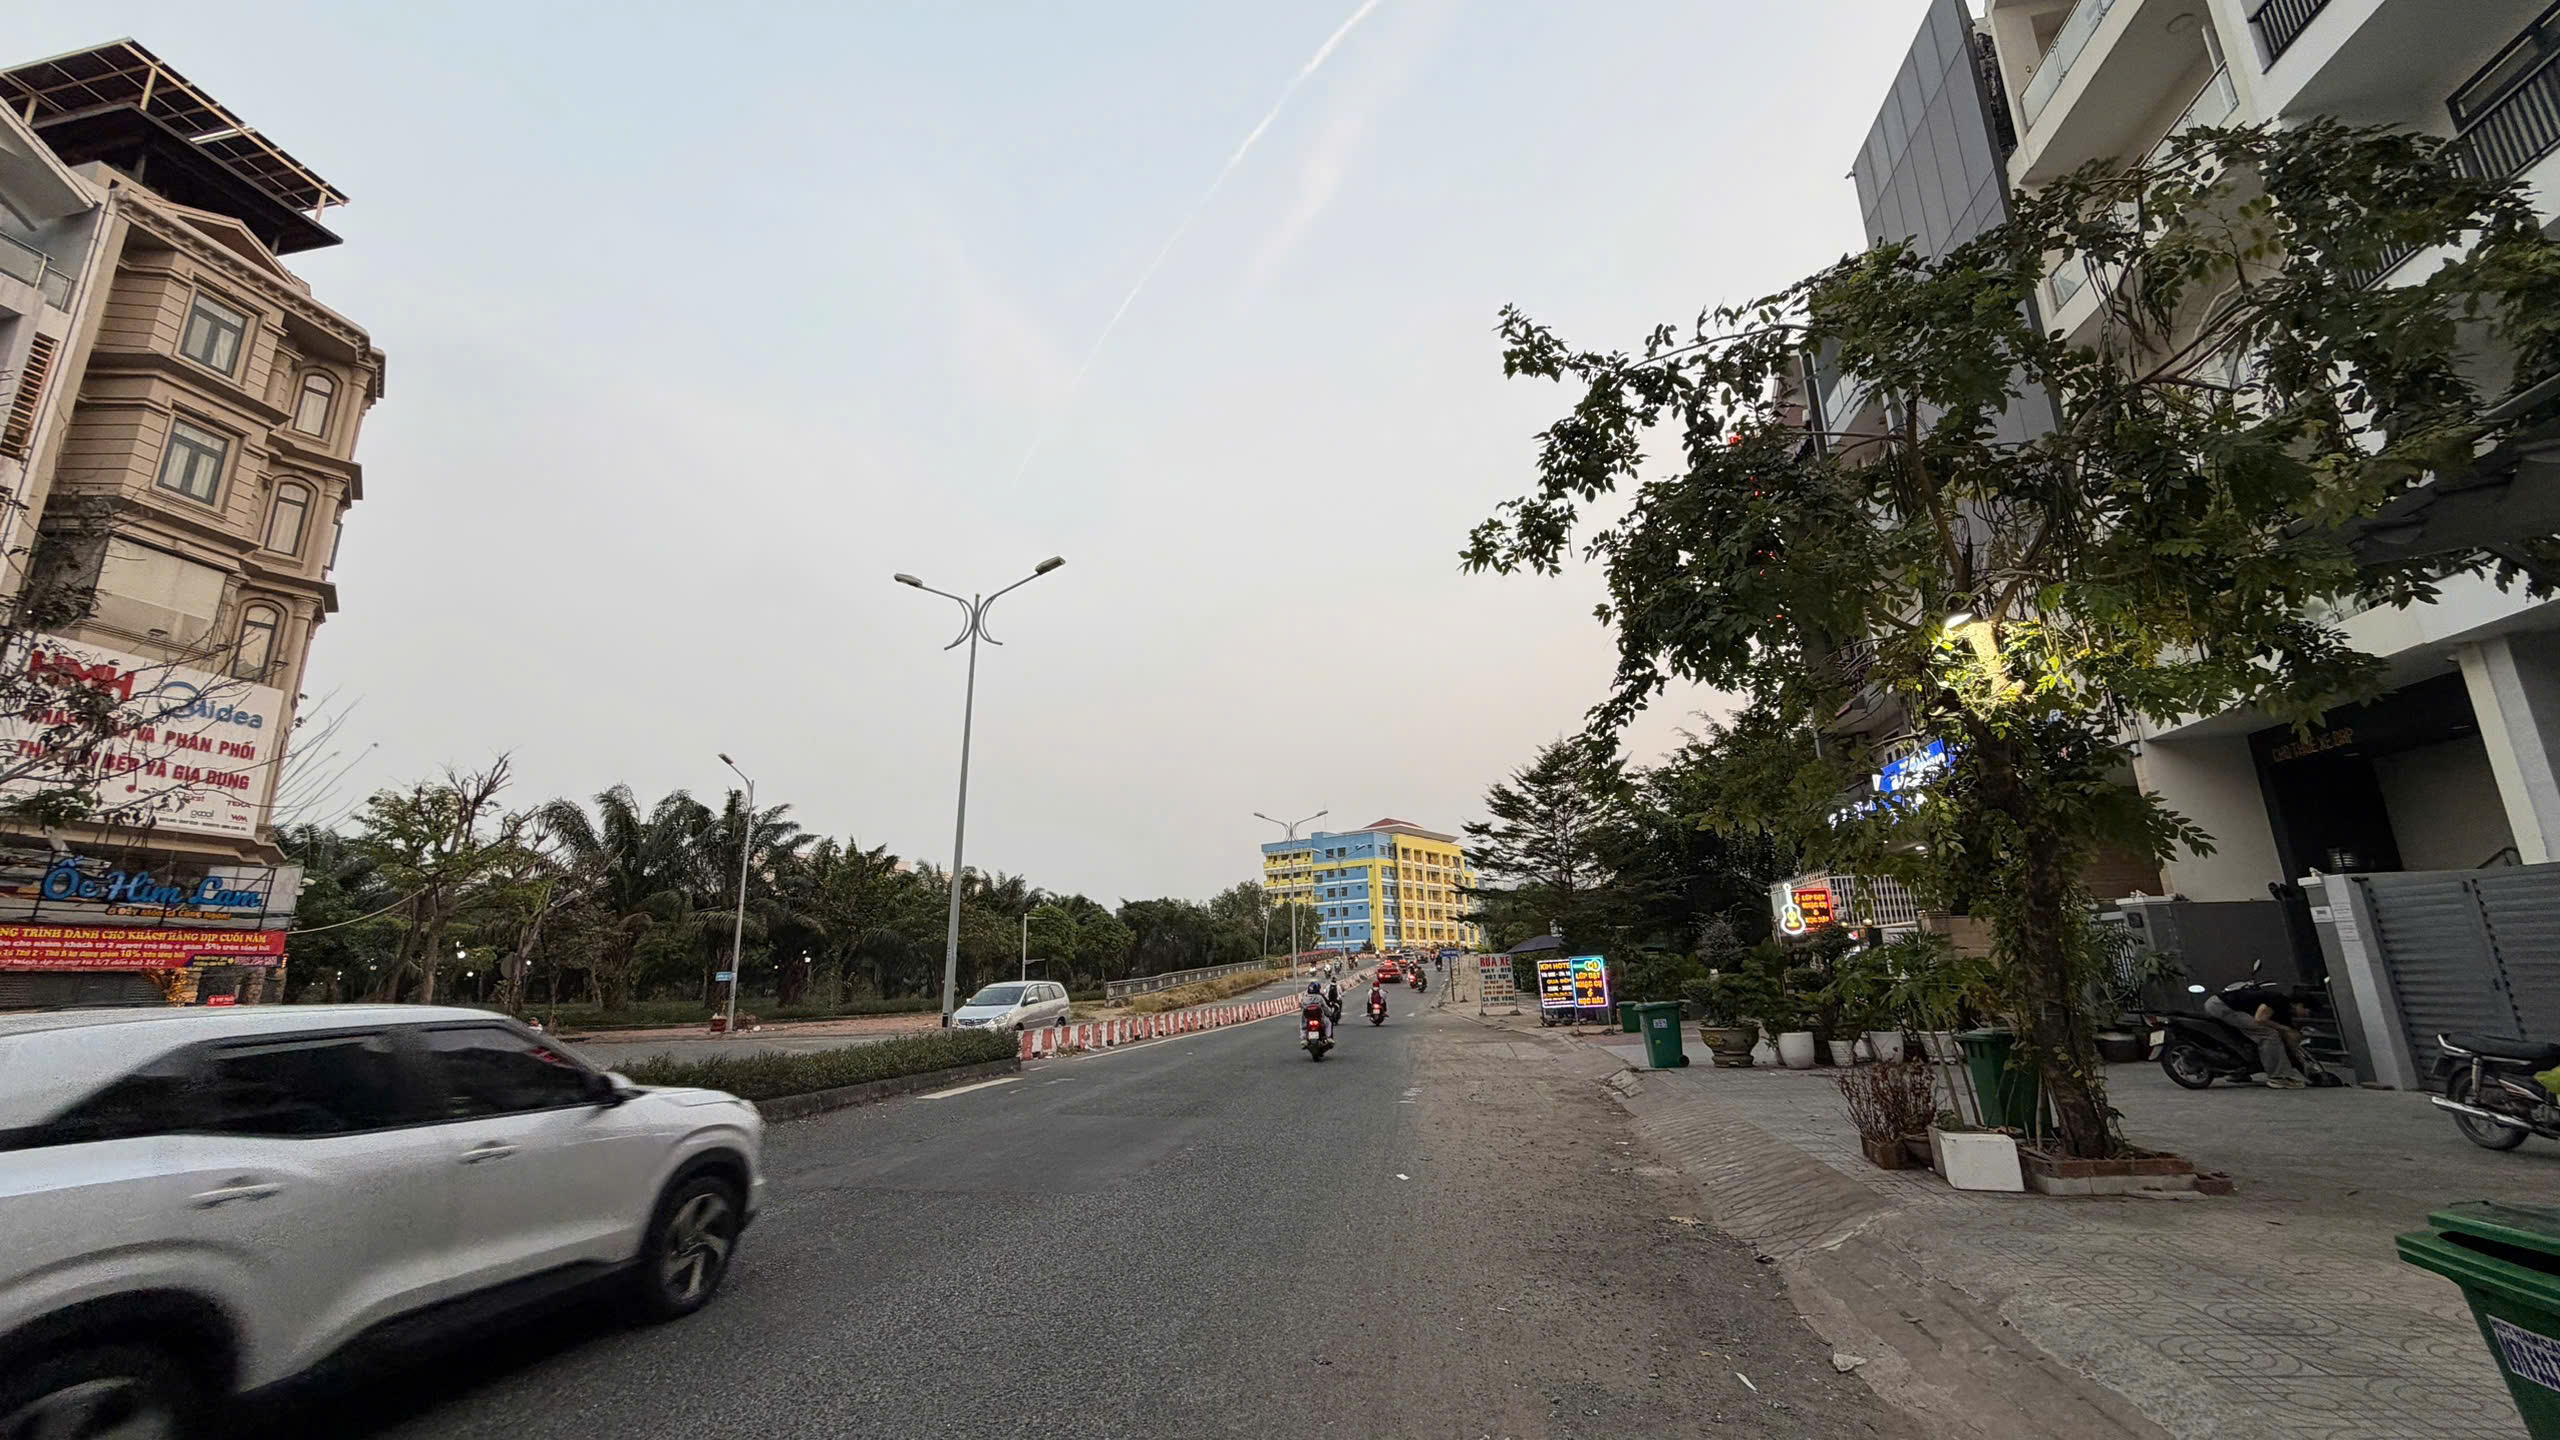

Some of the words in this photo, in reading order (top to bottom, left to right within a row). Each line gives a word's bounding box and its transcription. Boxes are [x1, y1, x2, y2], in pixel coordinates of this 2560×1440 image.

[217, 740, 256, 761] PHỐI
[187, 876, 263, 908] Lam
[1500, 956, 1511, 966] XE
